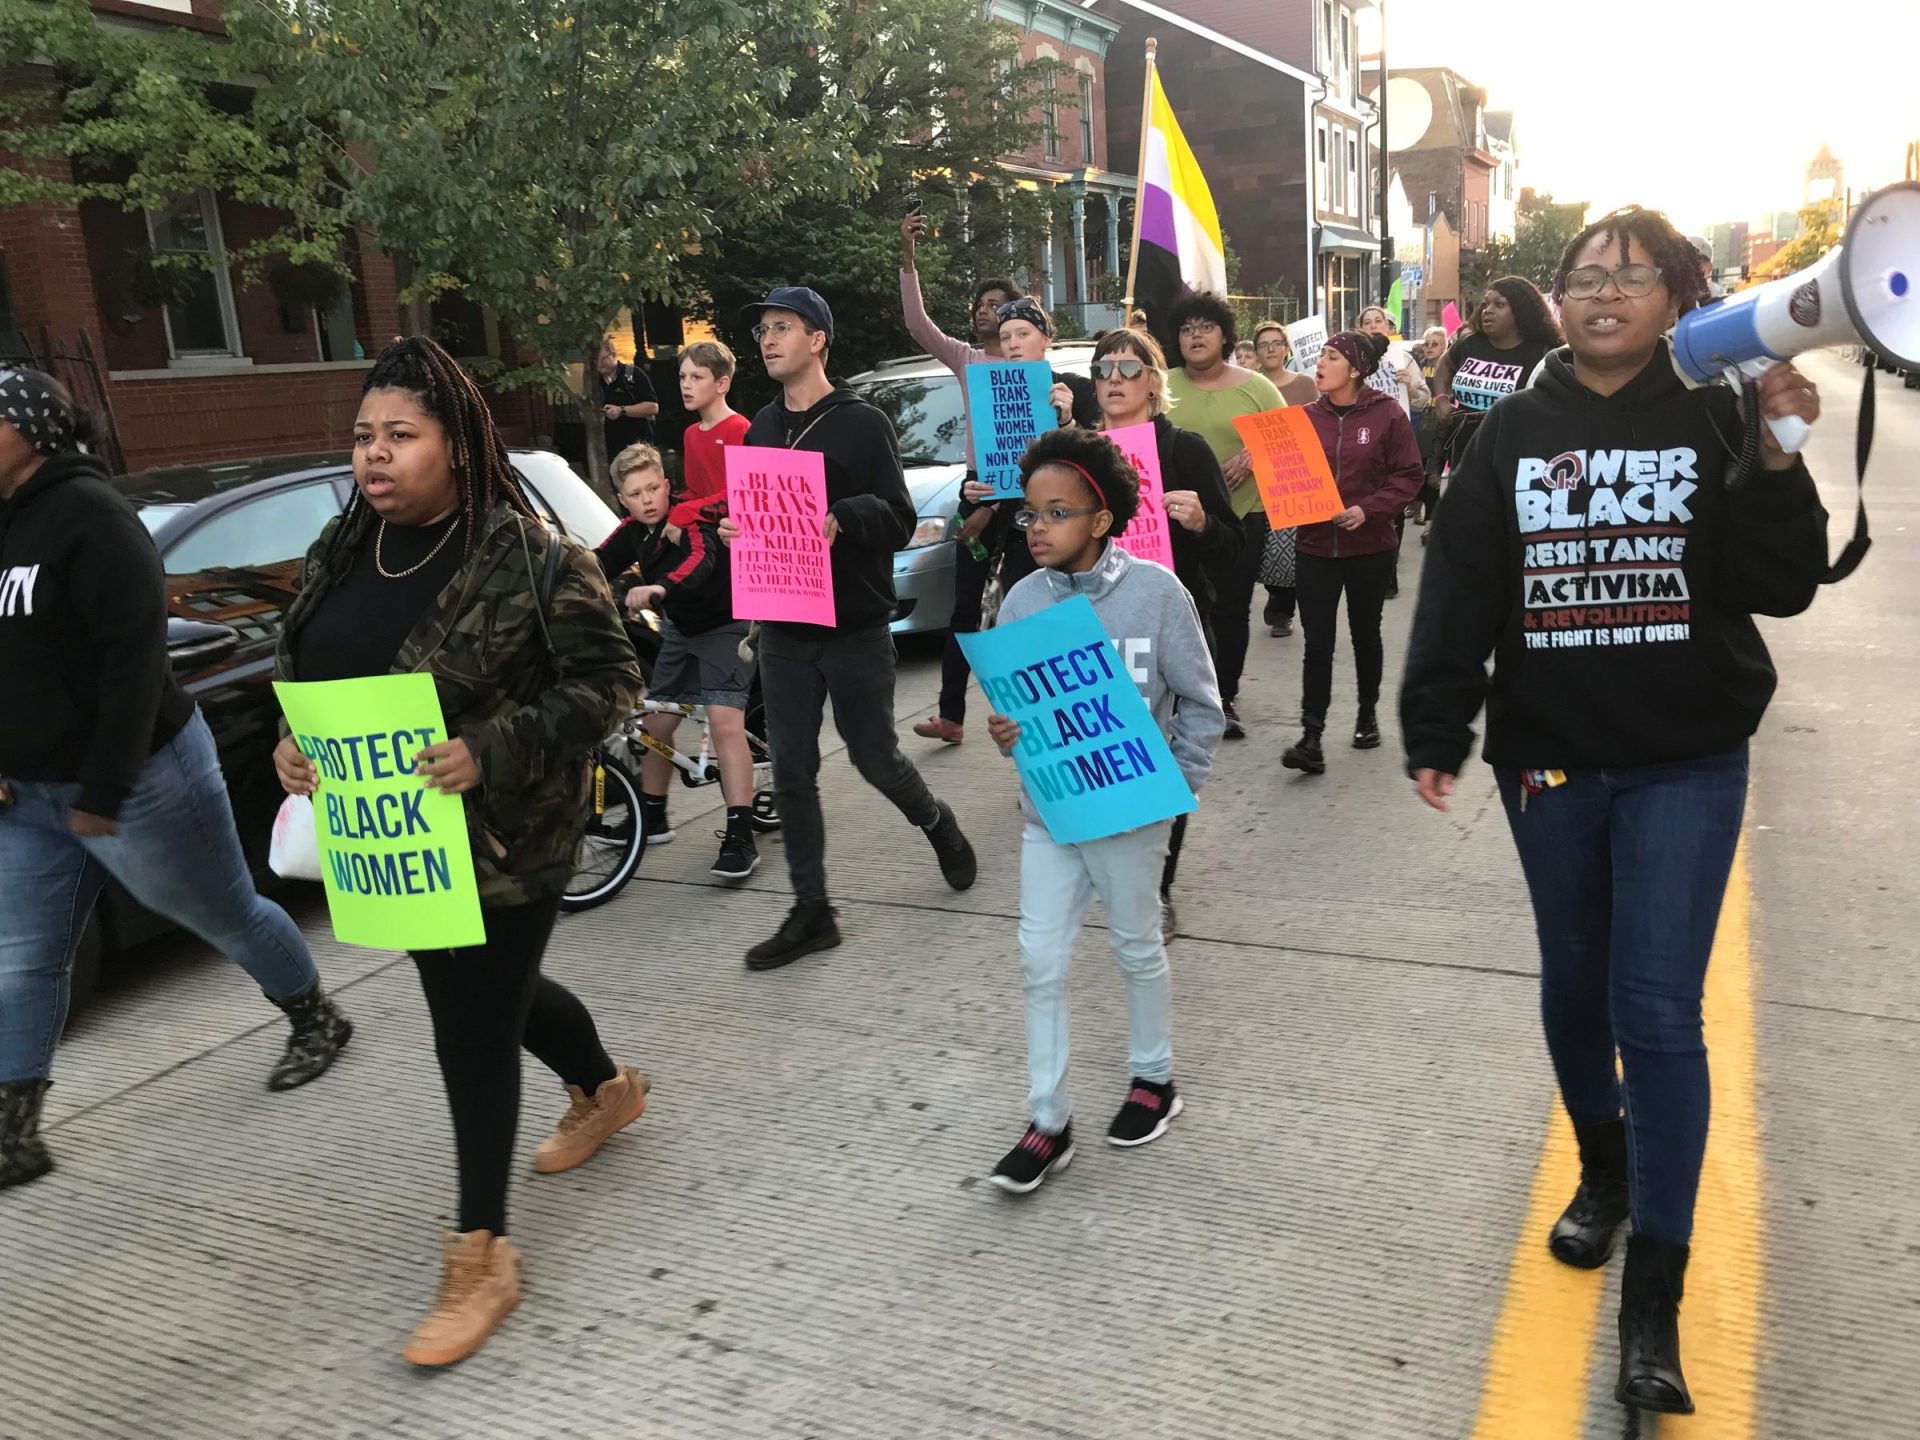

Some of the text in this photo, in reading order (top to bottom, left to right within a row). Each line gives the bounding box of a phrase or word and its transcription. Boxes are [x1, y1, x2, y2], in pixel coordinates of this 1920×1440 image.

[990, 369, 1027, 386] BLACK
[1460, 359, 1520, 381] BLACK
[992, 385, 1030, 403] TRANS
[1453, 374, 1514, 394] TRANS LIVES
[993, 402, 1033, 420] FEMME
[1253, 413, 1287, 429] BLACK
[994, 420, 1036, 435] WOMEN
[1259, 425, 1294, 442] TRANS
[1264, 438, 1300, 456] FEMME
[985, 452, 1009, 467] NON
[1270, 452, 1306, 469] WOMEN
[1515, 447, 1699, 491] POWER
[748, 472, 812, 495] BLACK
[1274, 465, 1311, 482] WOMYN
[1268, 477, 1324, 498] NON BINARY
[733, 489, 818, 518] TRANS
[1515, 480, 1698, 533] BLACK
[736, 513, 820, 538] WOMAN
[764, 534, 823, 553] KILLED
[766, 574, 792, 587] HER
[1527, 573, 1683, 604] ACTIVISM
[1523, 603, 1690, 629] & REVOLUTION
[1524, 624, 1690, 649] THE FIGHT IS NOT OVER!
[980, 640, 1114, 713] PROTECT
[1018, 693, 1126, 758] BLACK
[297, 727, 436, 782] PROTECT
[1028, 736, 1157, 803] WOMEN
[325, 788, 432, 840] BLACK
[328, 847, 452, 897] WOMEN
